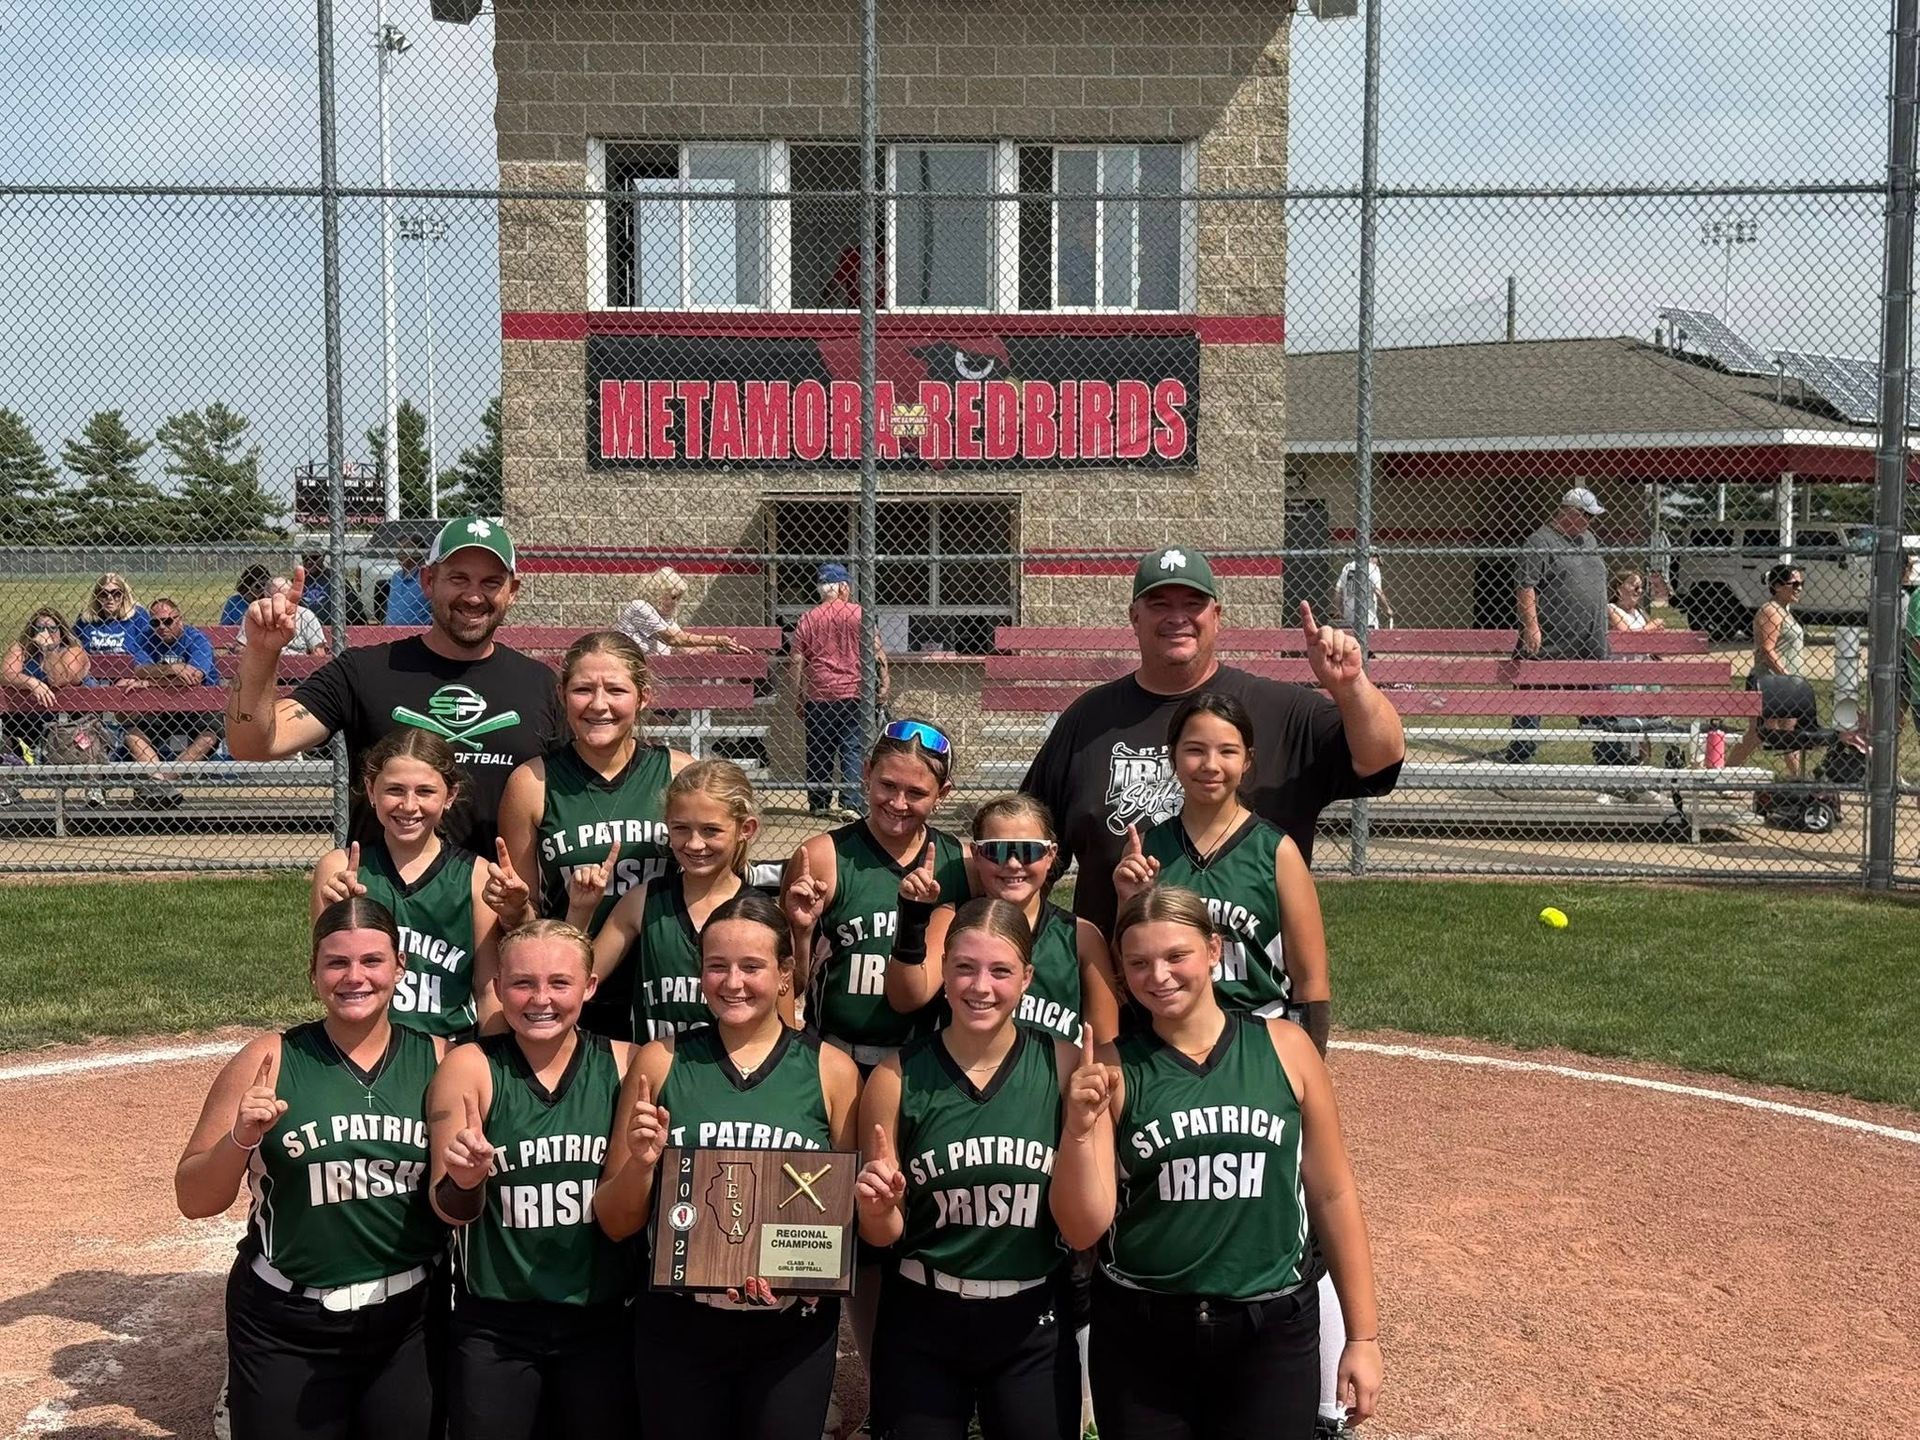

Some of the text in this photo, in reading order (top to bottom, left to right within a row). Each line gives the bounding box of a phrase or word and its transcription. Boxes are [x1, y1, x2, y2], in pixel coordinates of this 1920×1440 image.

[600, 379, 1188, 460] METAMORA REDBIRDS
[454, 752, 514, 766] OFTBALL
[541, 819, 670, 862] ST. PATRIC
[836, 916, 869, 947] ST.
[1200, 897, 1261, 940] RICK
[397, 925, 467, 974] TRICK
[643, 980, 659, 1006] T.
[1012, 993, 1078, 1037] RICK
[281, 1113, 430, 1159] ST. PATRIC
[519, 1133, 609, 1169] PATRIC
[1130, 1105, 1286, 1160] ST. PATRICK
[307, 1158, 427, 1208] IRISH
[909, 1148, 945, 1187] ST.
[1157, 1151, 1267, 1202] IRISH
[932, 1183, 1040, 1229] IRISH
[770, 1239, 834, 1250] CHAMPIONS
[776, 1229, 829, 1239] REGIONAL
